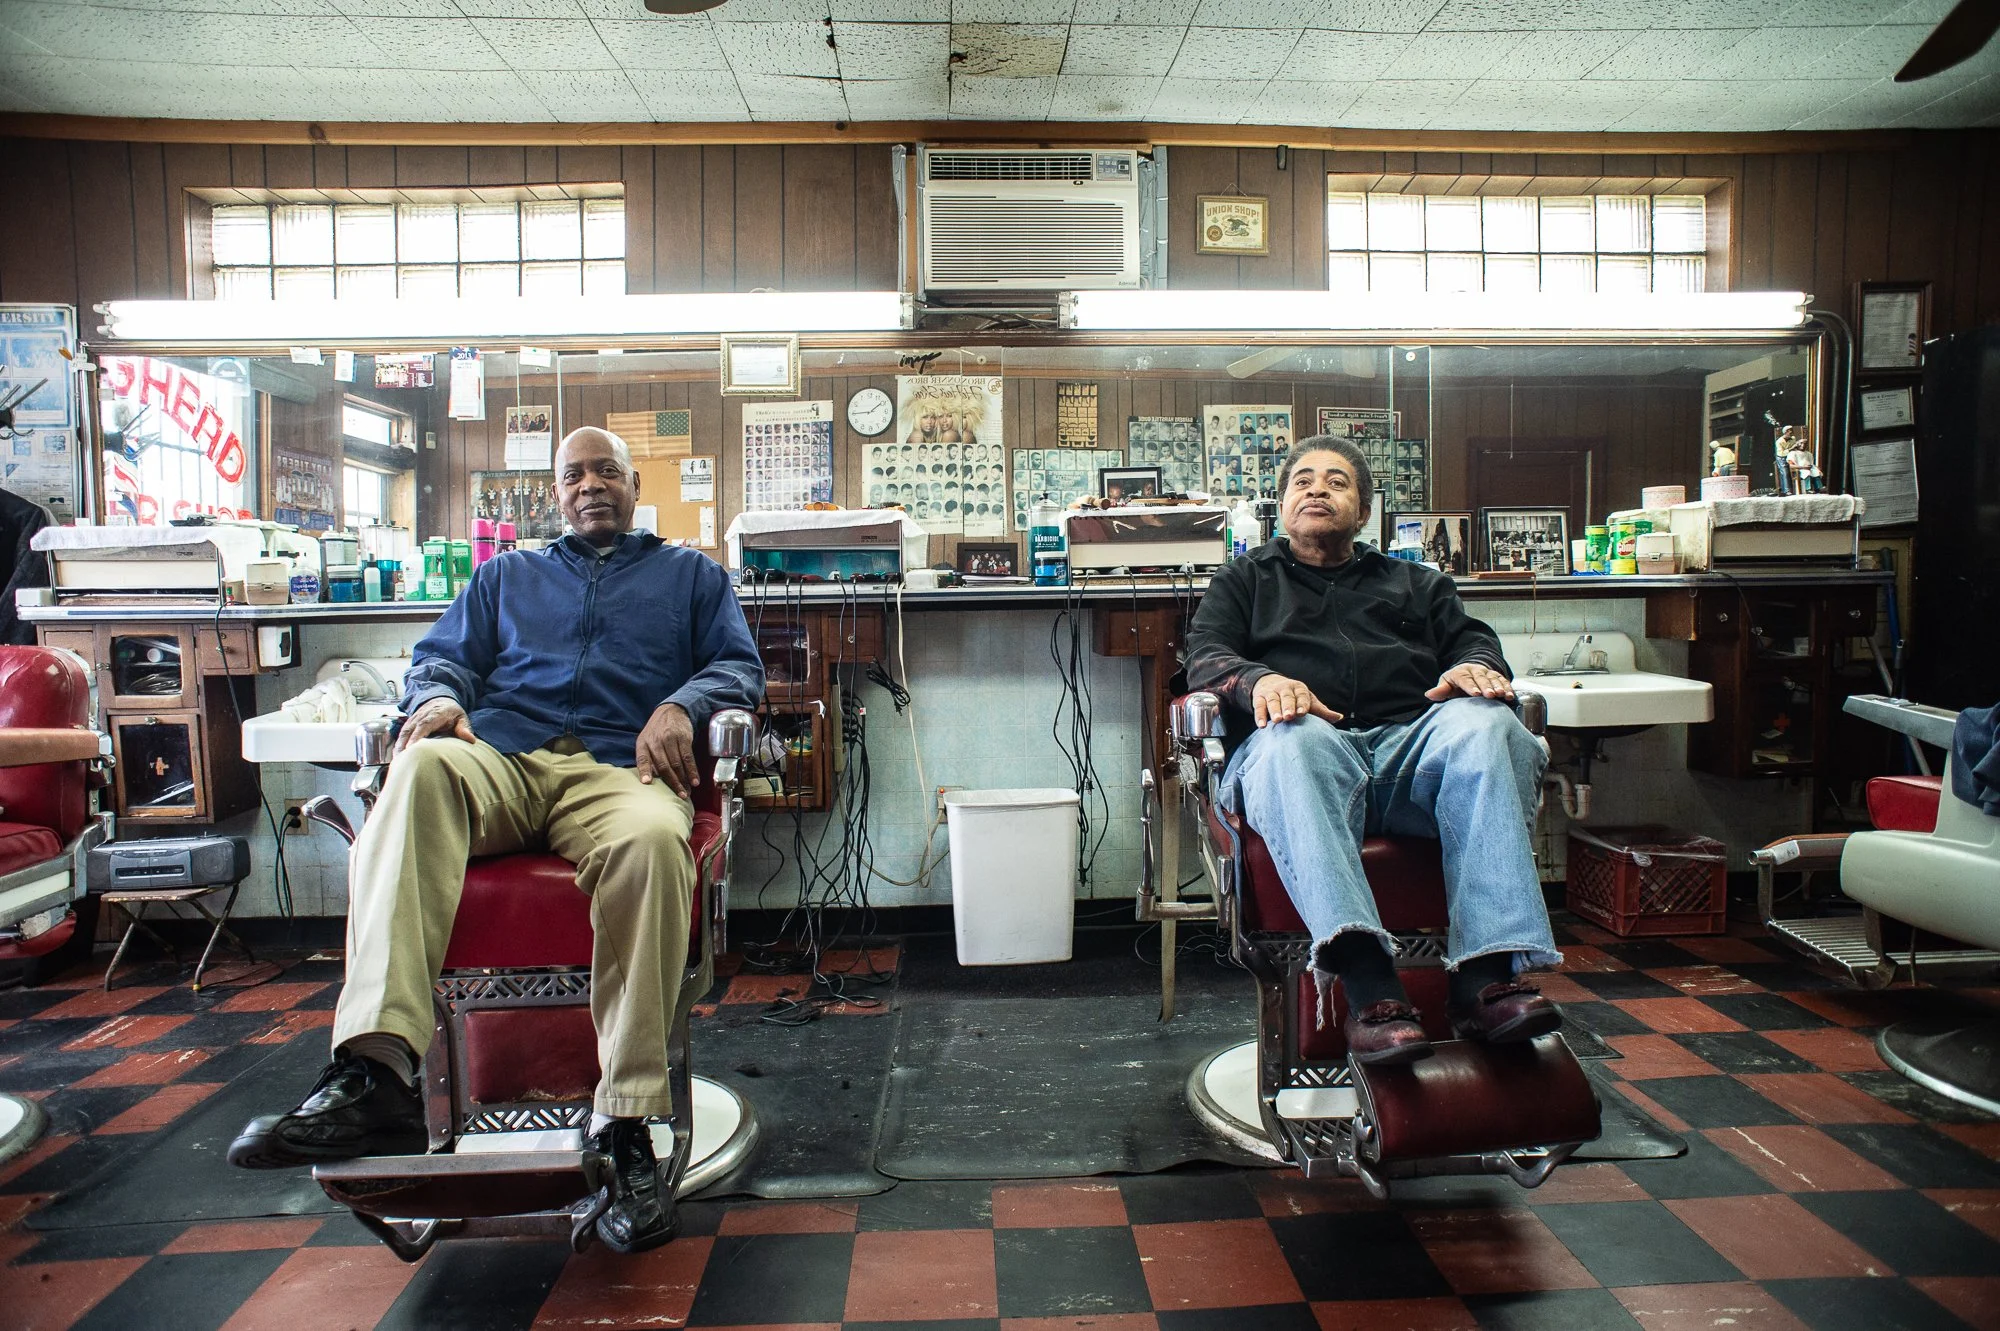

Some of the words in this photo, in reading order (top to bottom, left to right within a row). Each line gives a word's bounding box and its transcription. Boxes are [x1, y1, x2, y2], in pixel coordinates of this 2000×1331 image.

[1206, 204, 1233, 217] UNION
[457, 352, 472, 361] 2013
[1034, 533, 1059, 543] BARBICIDE
